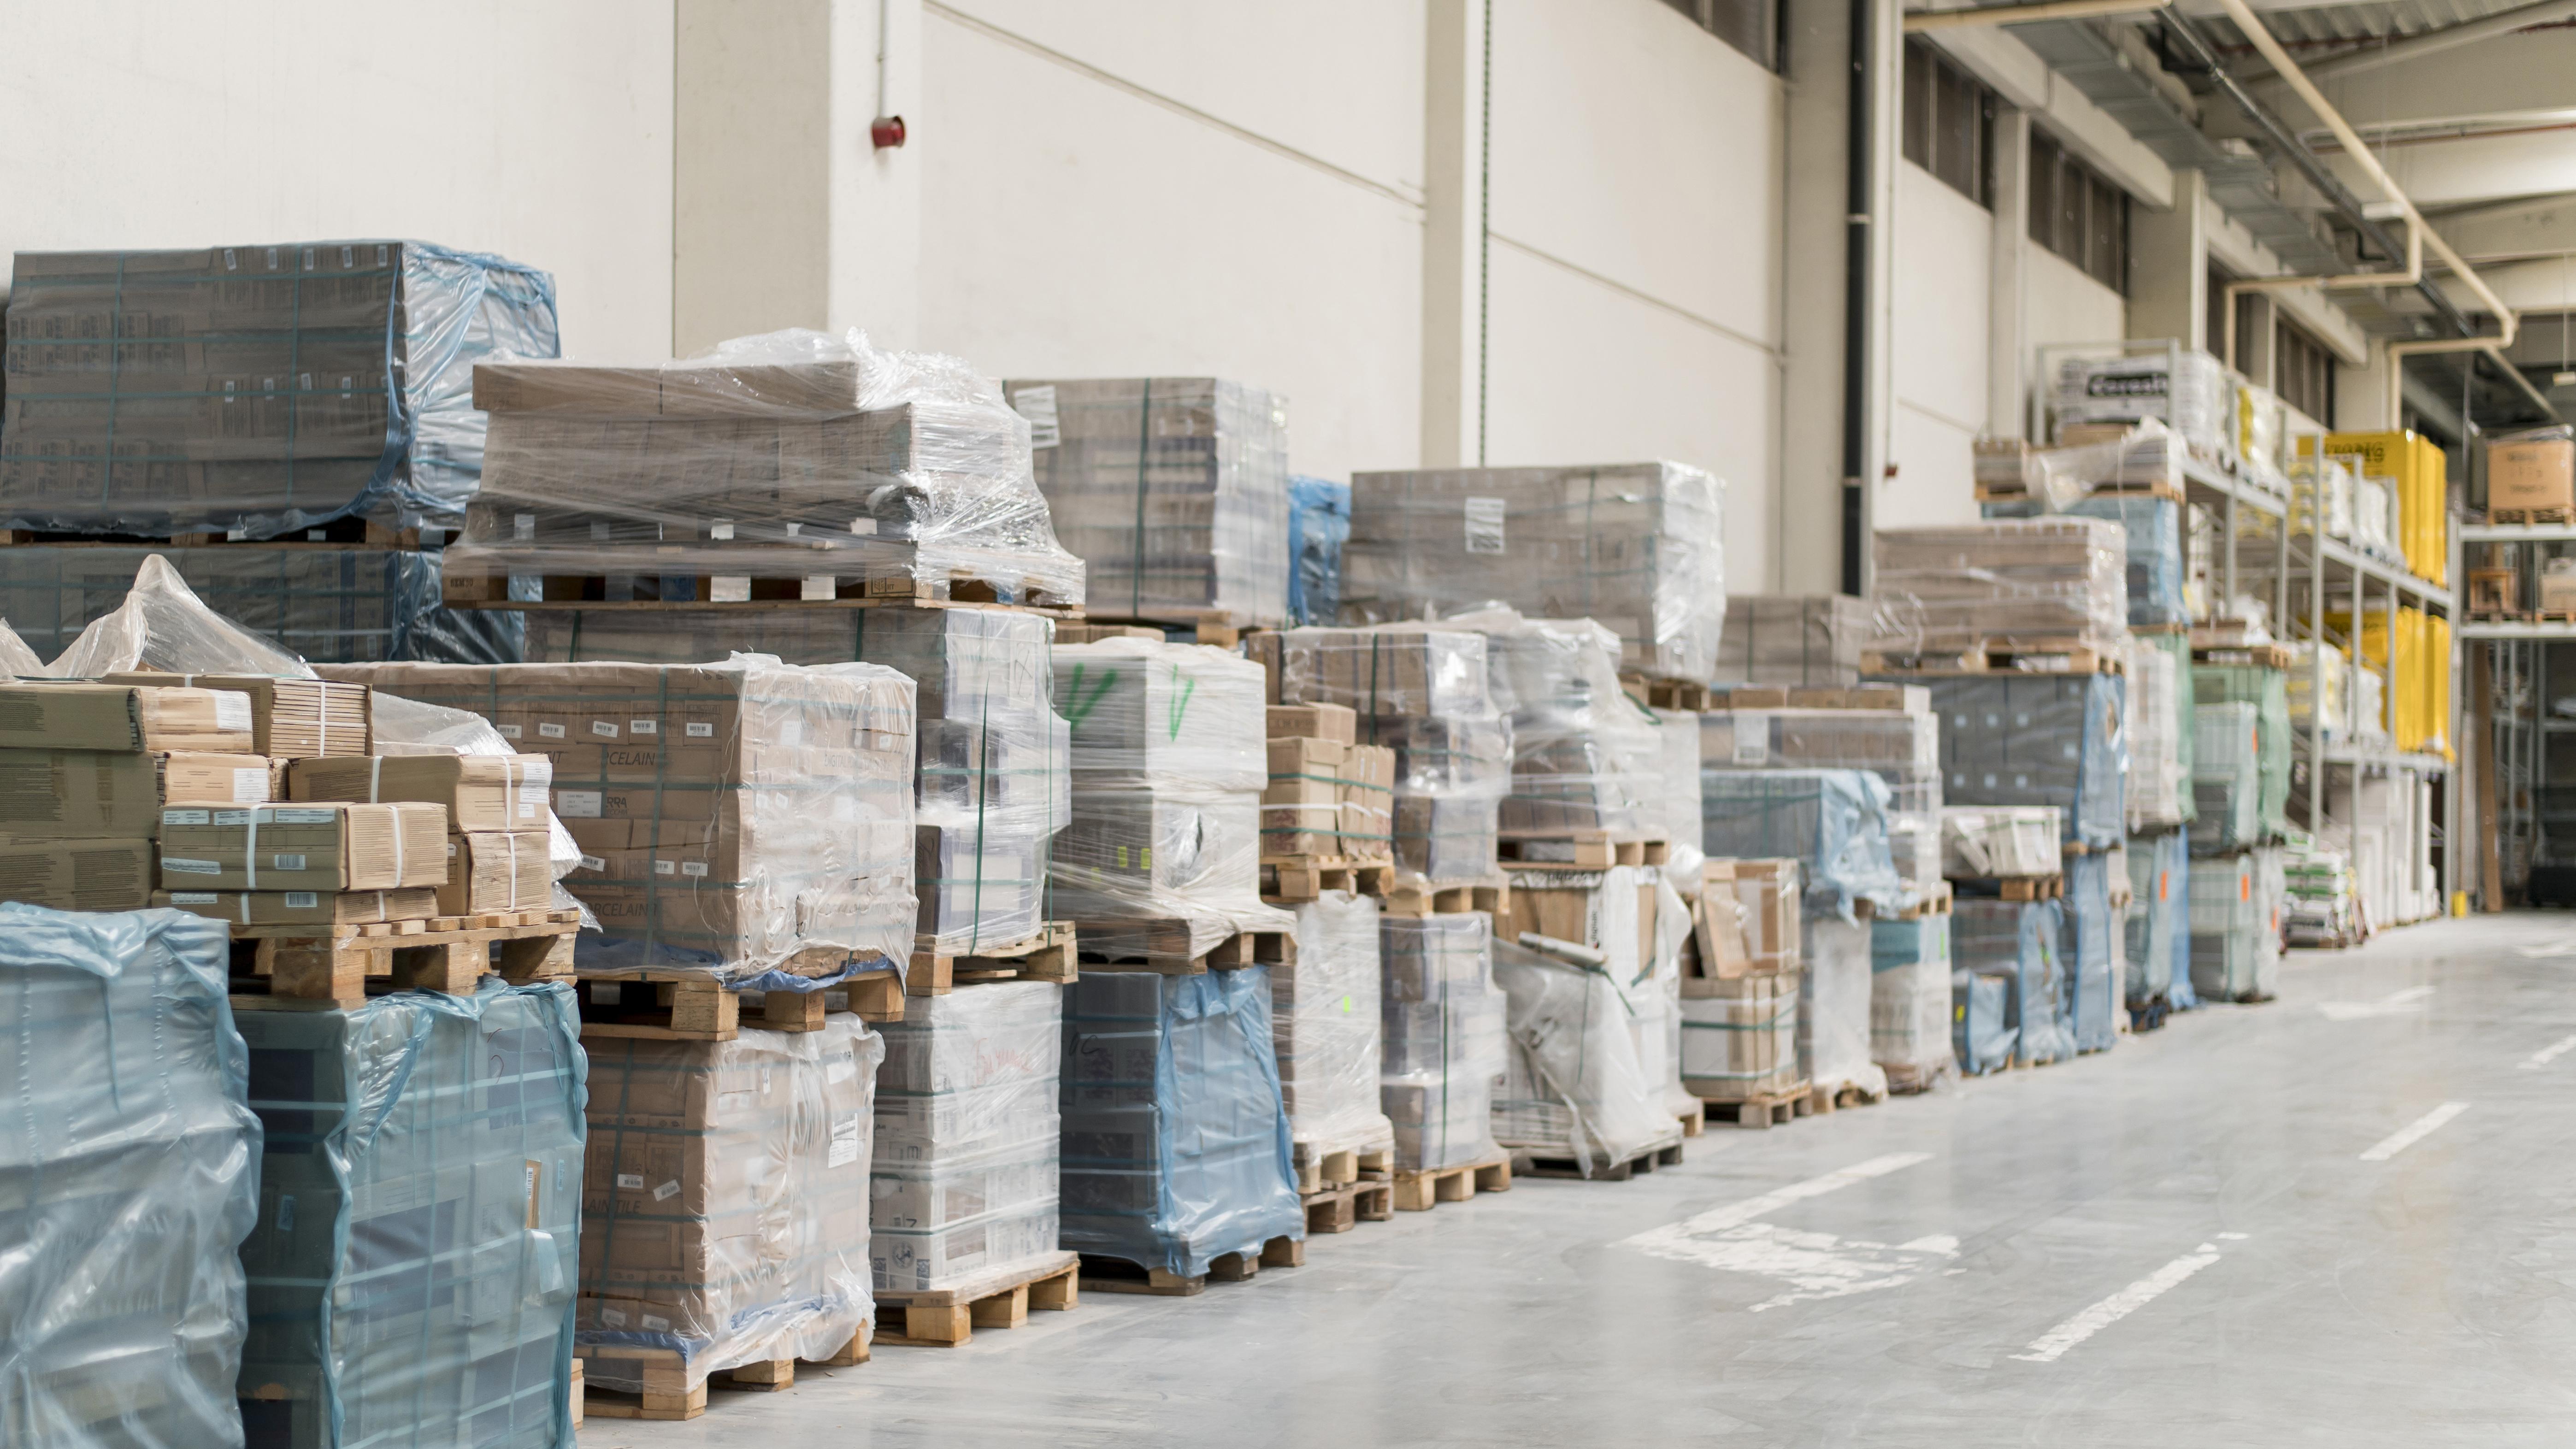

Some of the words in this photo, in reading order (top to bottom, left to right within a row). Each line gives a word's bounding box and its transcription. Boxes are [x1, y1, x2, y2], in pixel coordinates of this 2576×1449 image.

[606, 751, 655, 766] RCELAIN
[607, 797, 627, 808] RRA
[588, 903, 648, 916] ORCELAIN
